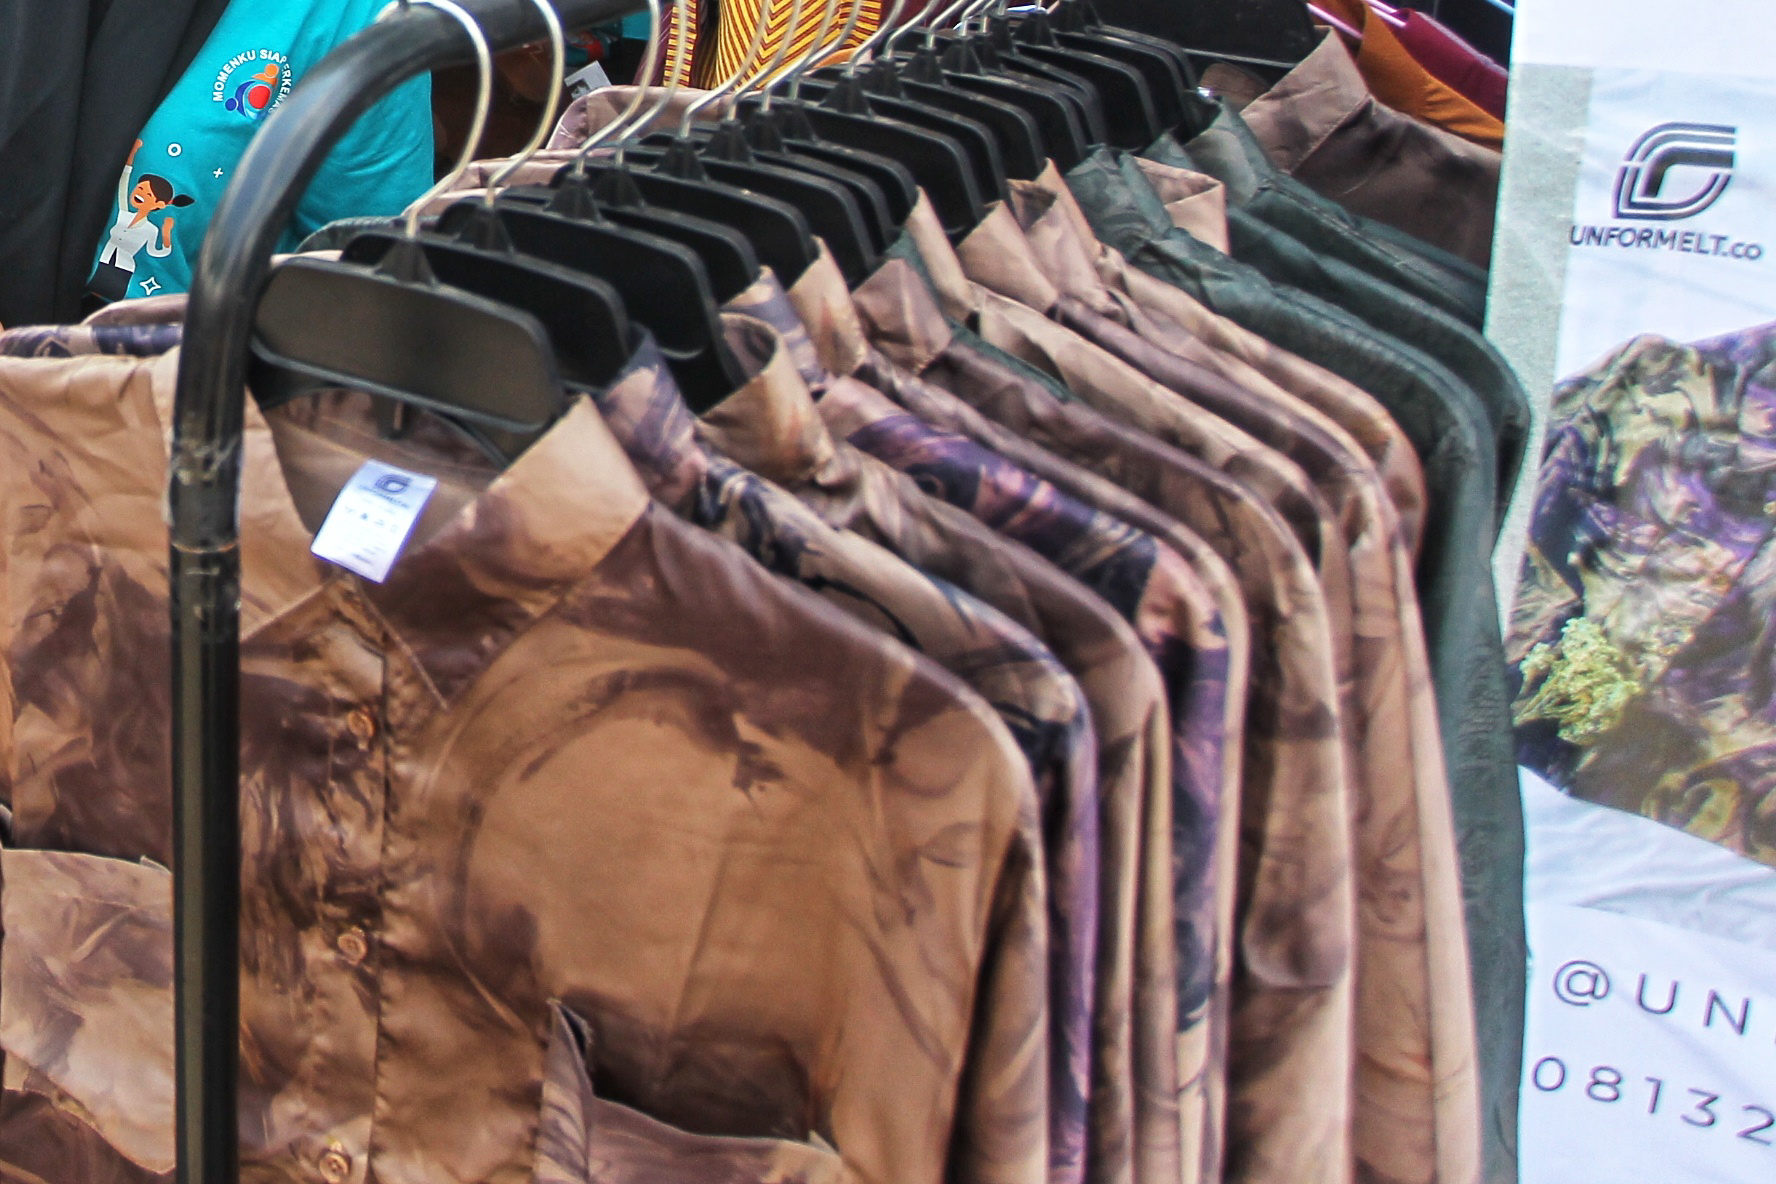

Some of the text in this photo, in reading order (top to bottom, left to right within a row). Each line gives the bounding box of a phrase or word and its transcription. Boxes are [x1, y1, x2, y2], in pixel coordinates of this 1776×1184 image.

[212, 48, 292, 113] MOMENKU SIAP ERKEMA
[1530, 1055, 1776, 1146] 08132
